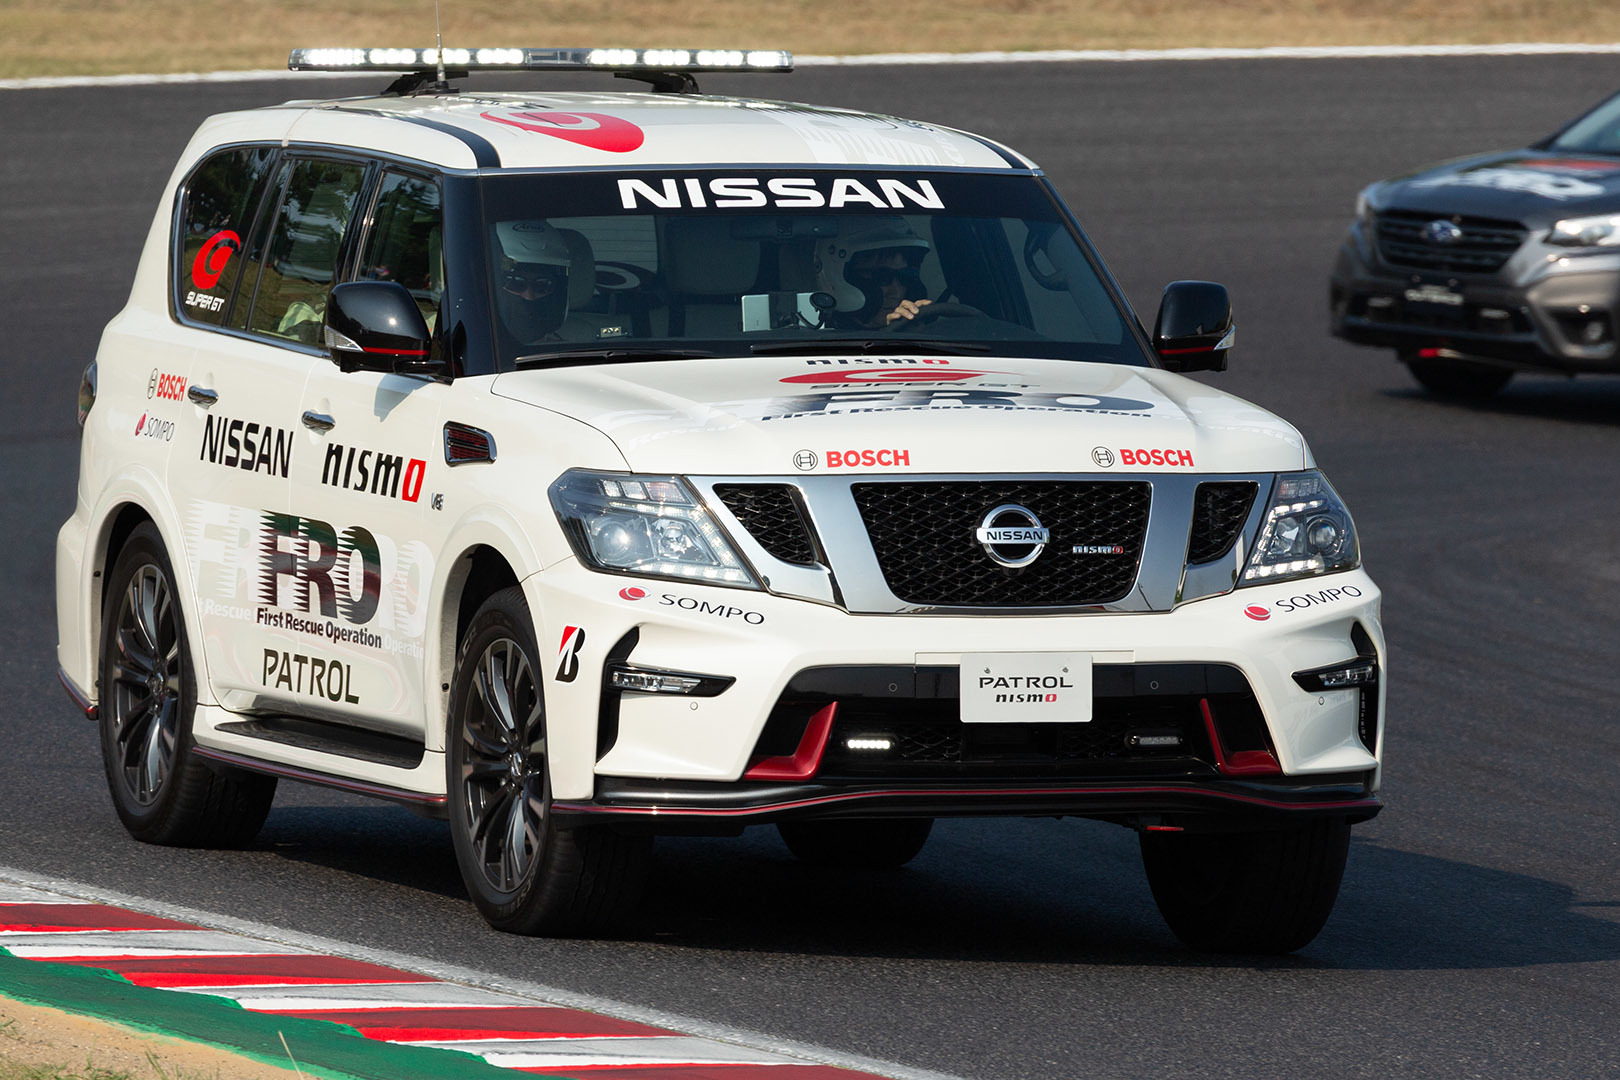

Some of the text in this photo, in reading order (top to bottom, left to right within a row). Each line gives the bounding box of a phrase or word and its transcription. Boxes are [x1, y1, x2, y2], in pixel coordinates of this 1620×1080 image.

[617, 178, 946, 210] NISSAN
[185, 291, 225, 312] SUPER GT
[157, 373, 188, 402] BOSCH
[762, 389, 1156, 412] FRO
[144, 417, 175, 442] SOMPO
[200, 413, 294, 479] NISSAN
[826, 449, 910, 468] BOSCH
[1120, 449, 1195, 467] BOSCH
[986, 531, 1043, 541] NISSAN
[257, 509, 382, 625] FRO
[658, 593, 765, 626] SOMPO
[1276, 584, 1363, 613] SOMPO
[256, 607, 382, 649] First Rescue Operation
[262, 647, 360, 705] PATROL
[979, 676, 1074, 689] PATROL
